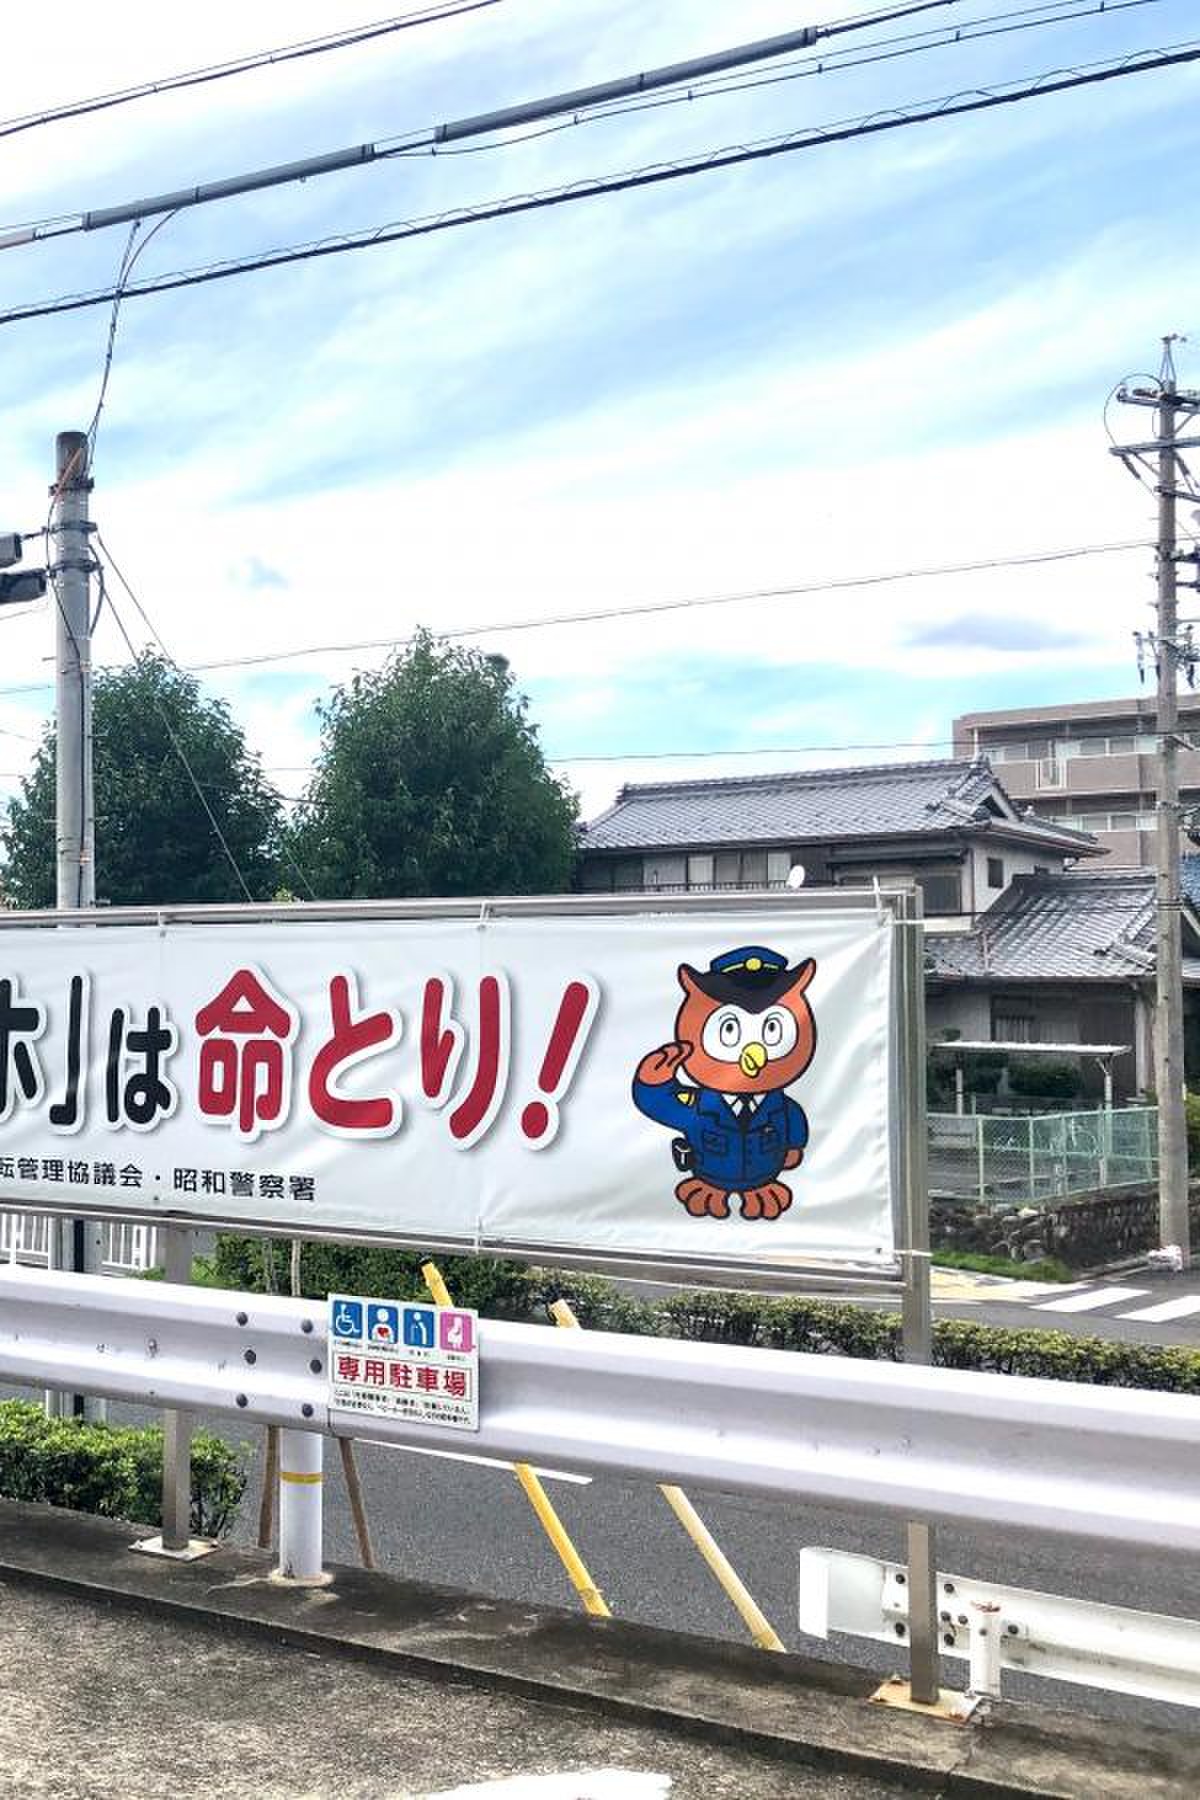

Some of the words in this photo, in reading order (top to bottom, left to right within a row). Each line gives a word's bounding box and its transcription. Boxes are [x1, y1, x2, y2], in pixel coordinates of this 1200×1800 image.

[337, 1355, 466, 1397] 専用駐車場
